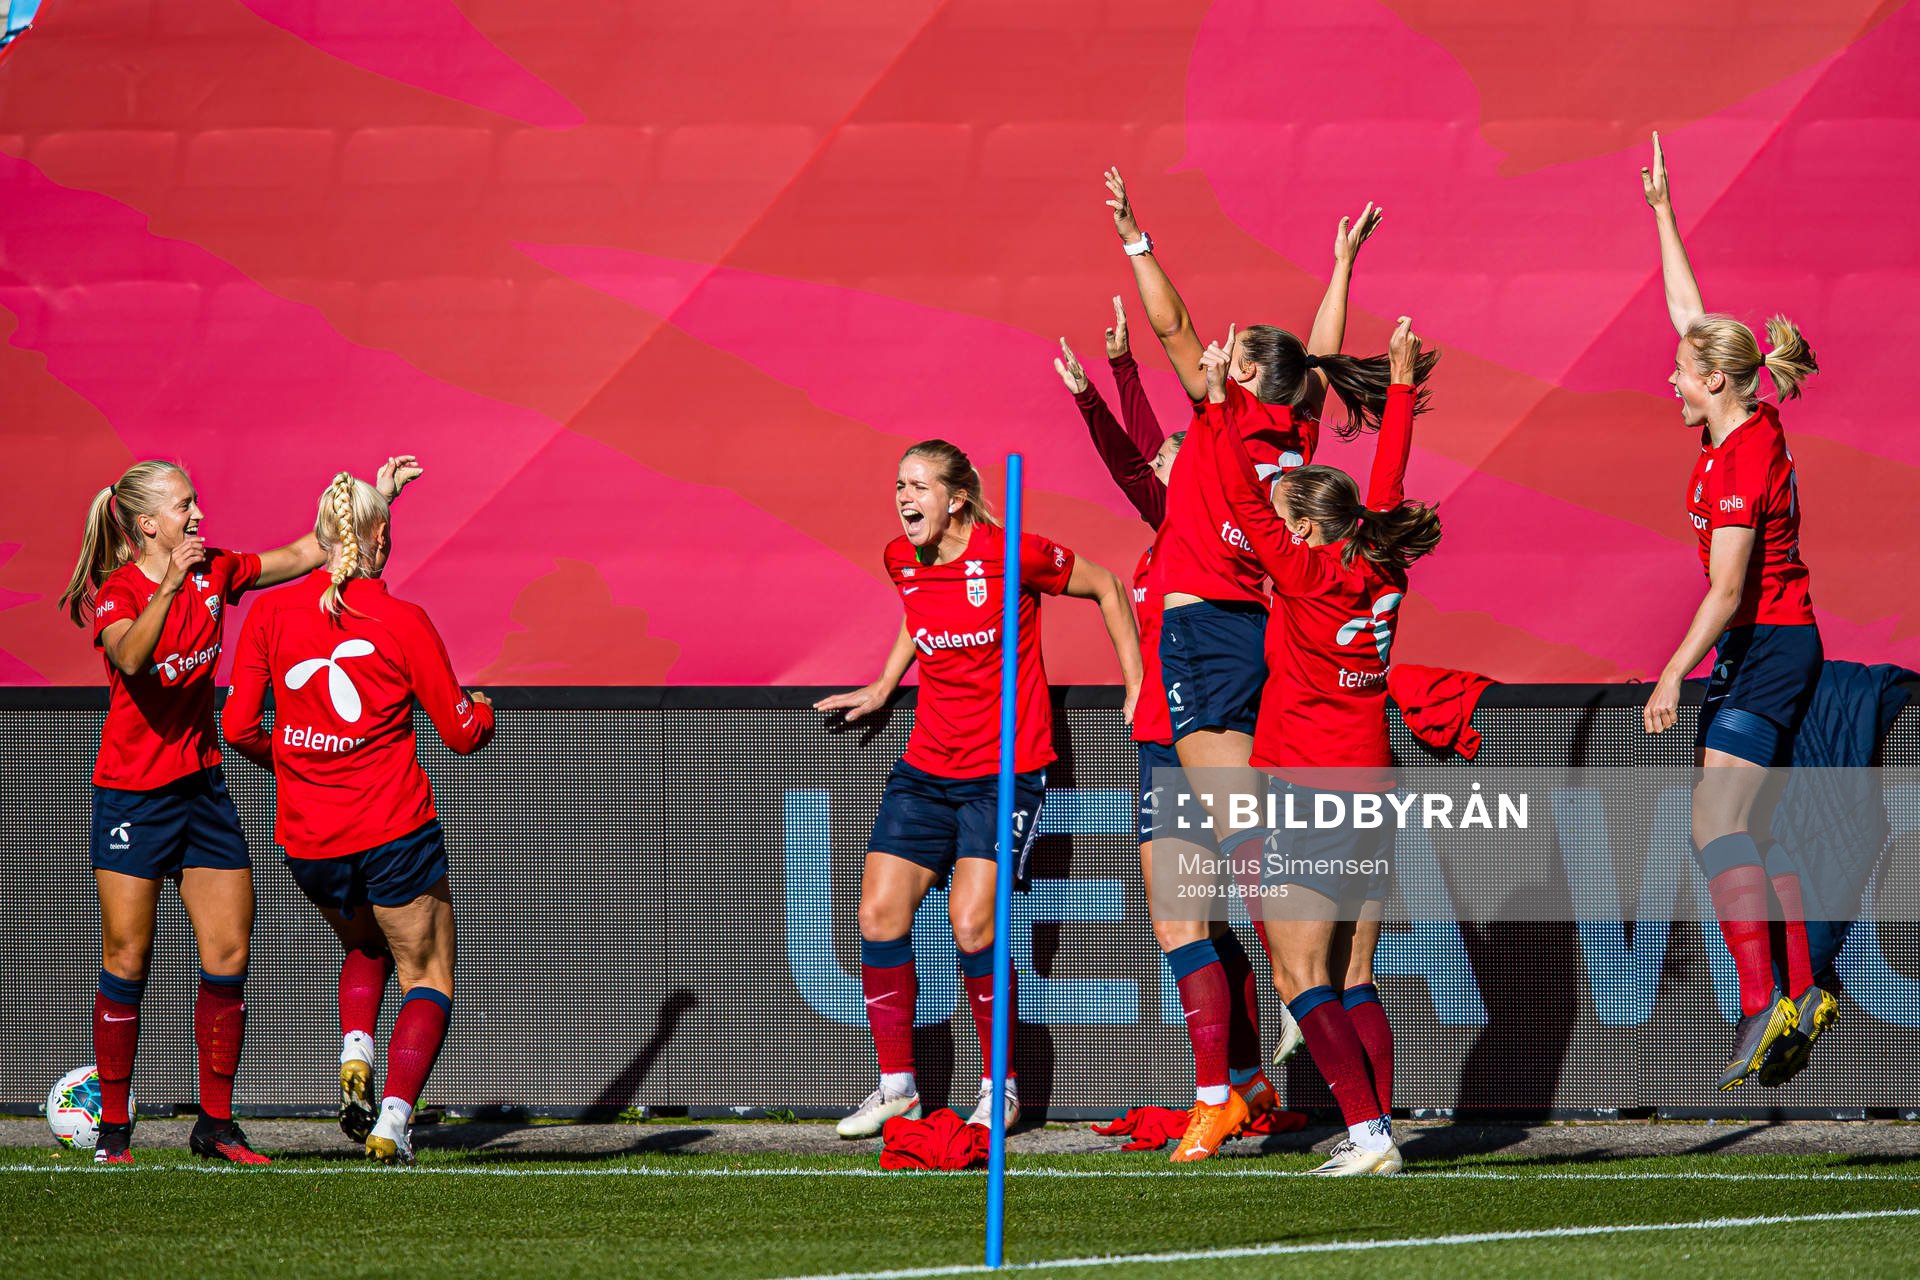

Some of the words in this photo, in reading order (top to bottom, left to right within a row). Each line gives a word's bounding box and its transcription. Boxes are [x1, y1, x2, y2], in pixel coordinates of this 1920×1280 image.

[1719, 494, 1744, 513] DNB
[96, 600, 115, 618] DNB
[926, 627, 997, 650] telenor
[283, 724, 366, 753] telenor
